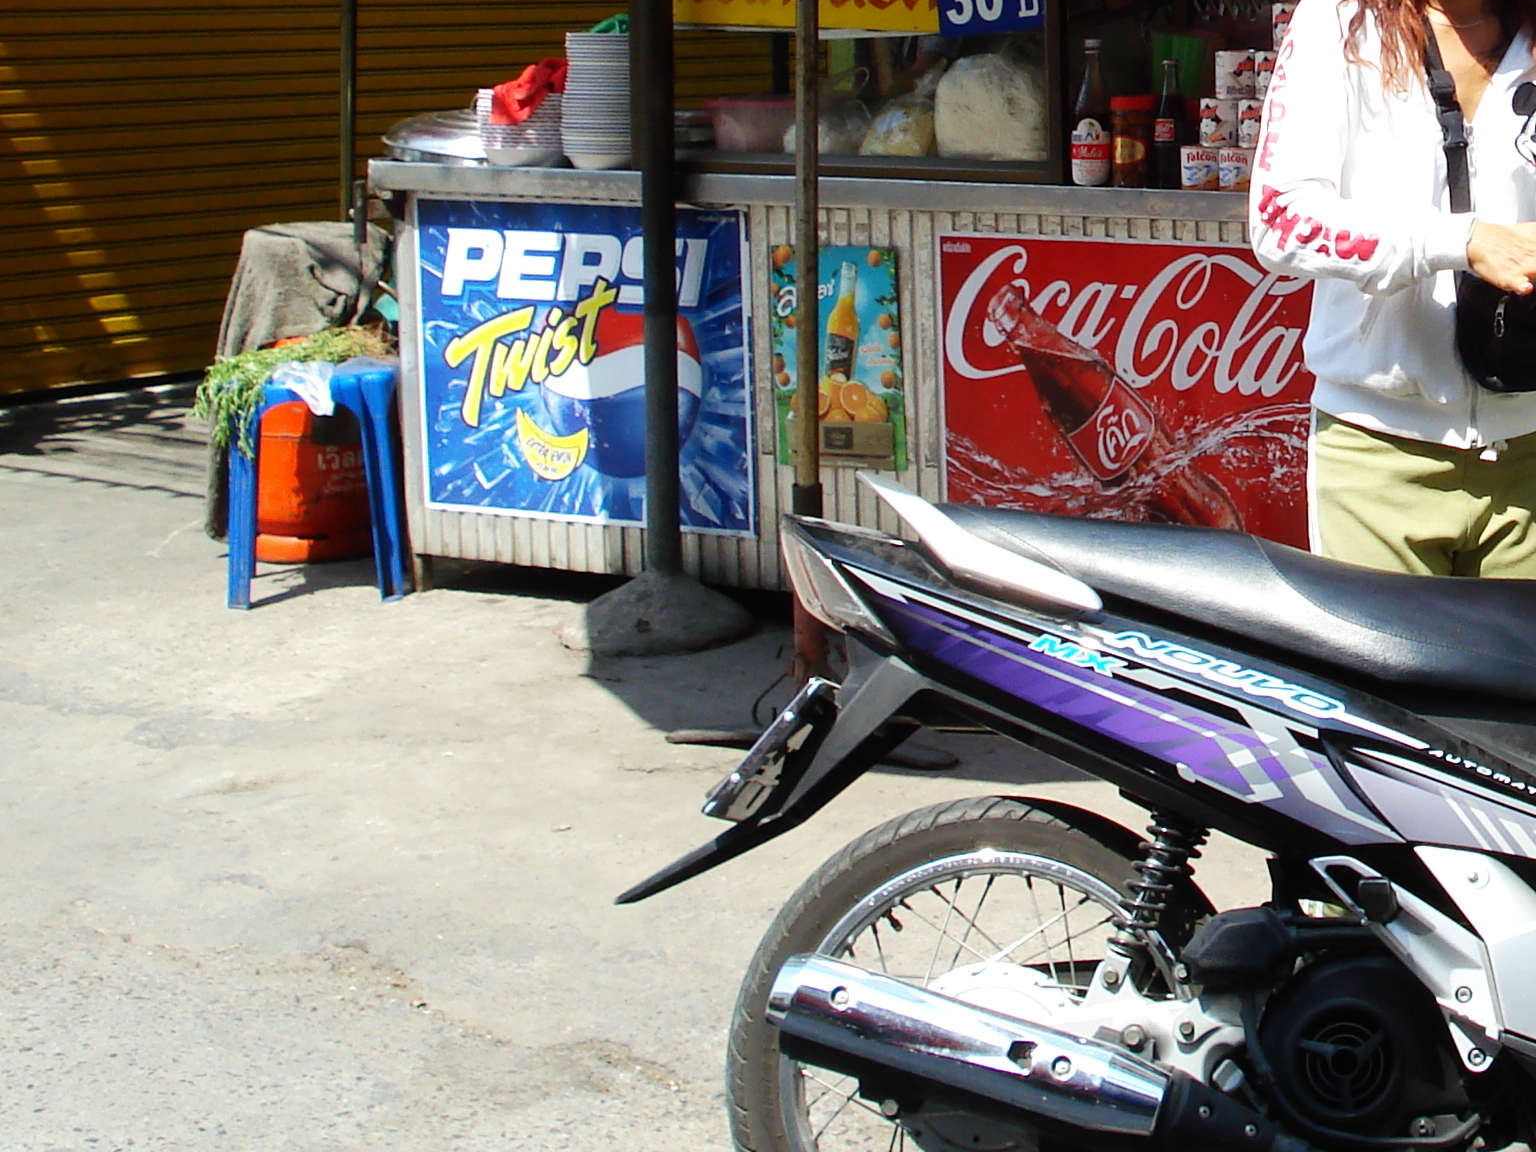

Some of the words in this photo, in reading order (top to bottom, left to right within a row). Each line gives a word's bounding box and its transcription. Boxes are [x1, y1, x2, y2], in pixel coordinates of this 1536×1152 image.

[443, 276, 619, 428] Twist
[945, 244, 1313, 397] Coca-Cola
[1027, 633, 1129, 678] MX
[1104, 630, 1347, 719] NOUVO
